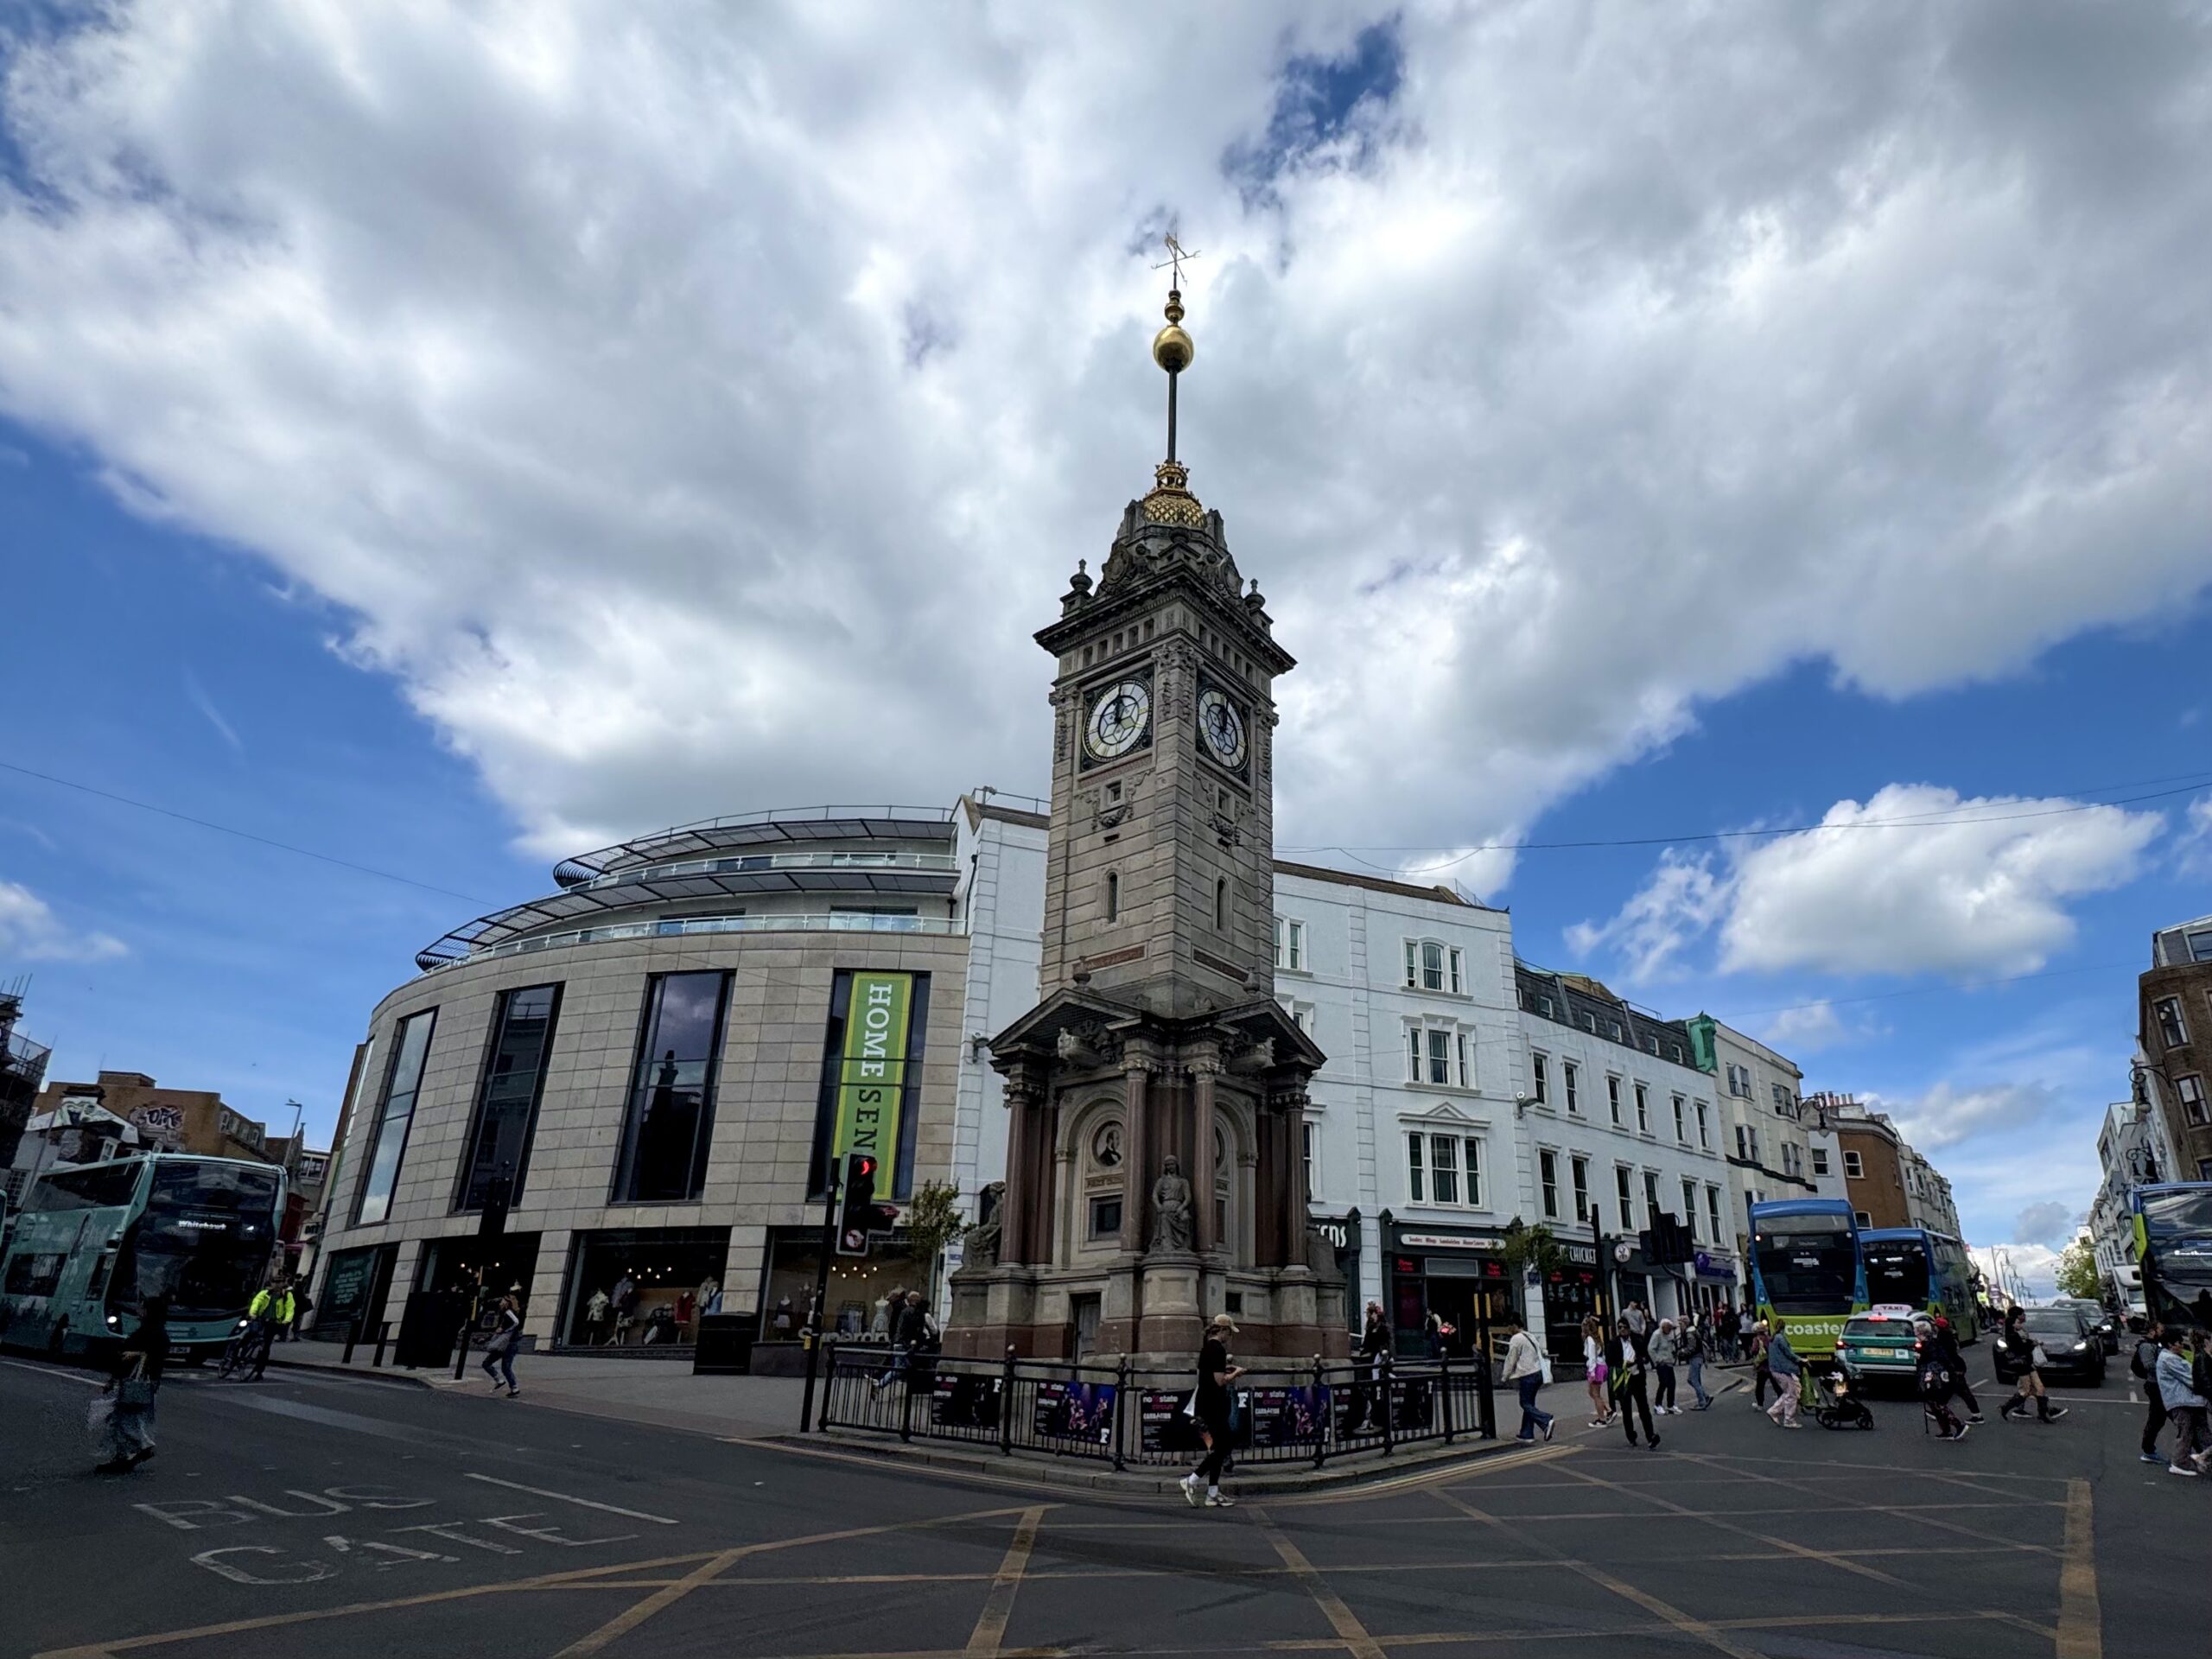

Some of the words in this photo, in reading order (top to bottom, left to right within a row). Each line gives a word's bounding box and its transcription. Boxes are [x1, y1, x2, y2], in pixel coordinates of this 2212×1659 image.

[861, 983, 893, 1077] HOME
[1237, 1391, 1249, 1408] F
[131, 1484, 437, 1530] BUS
